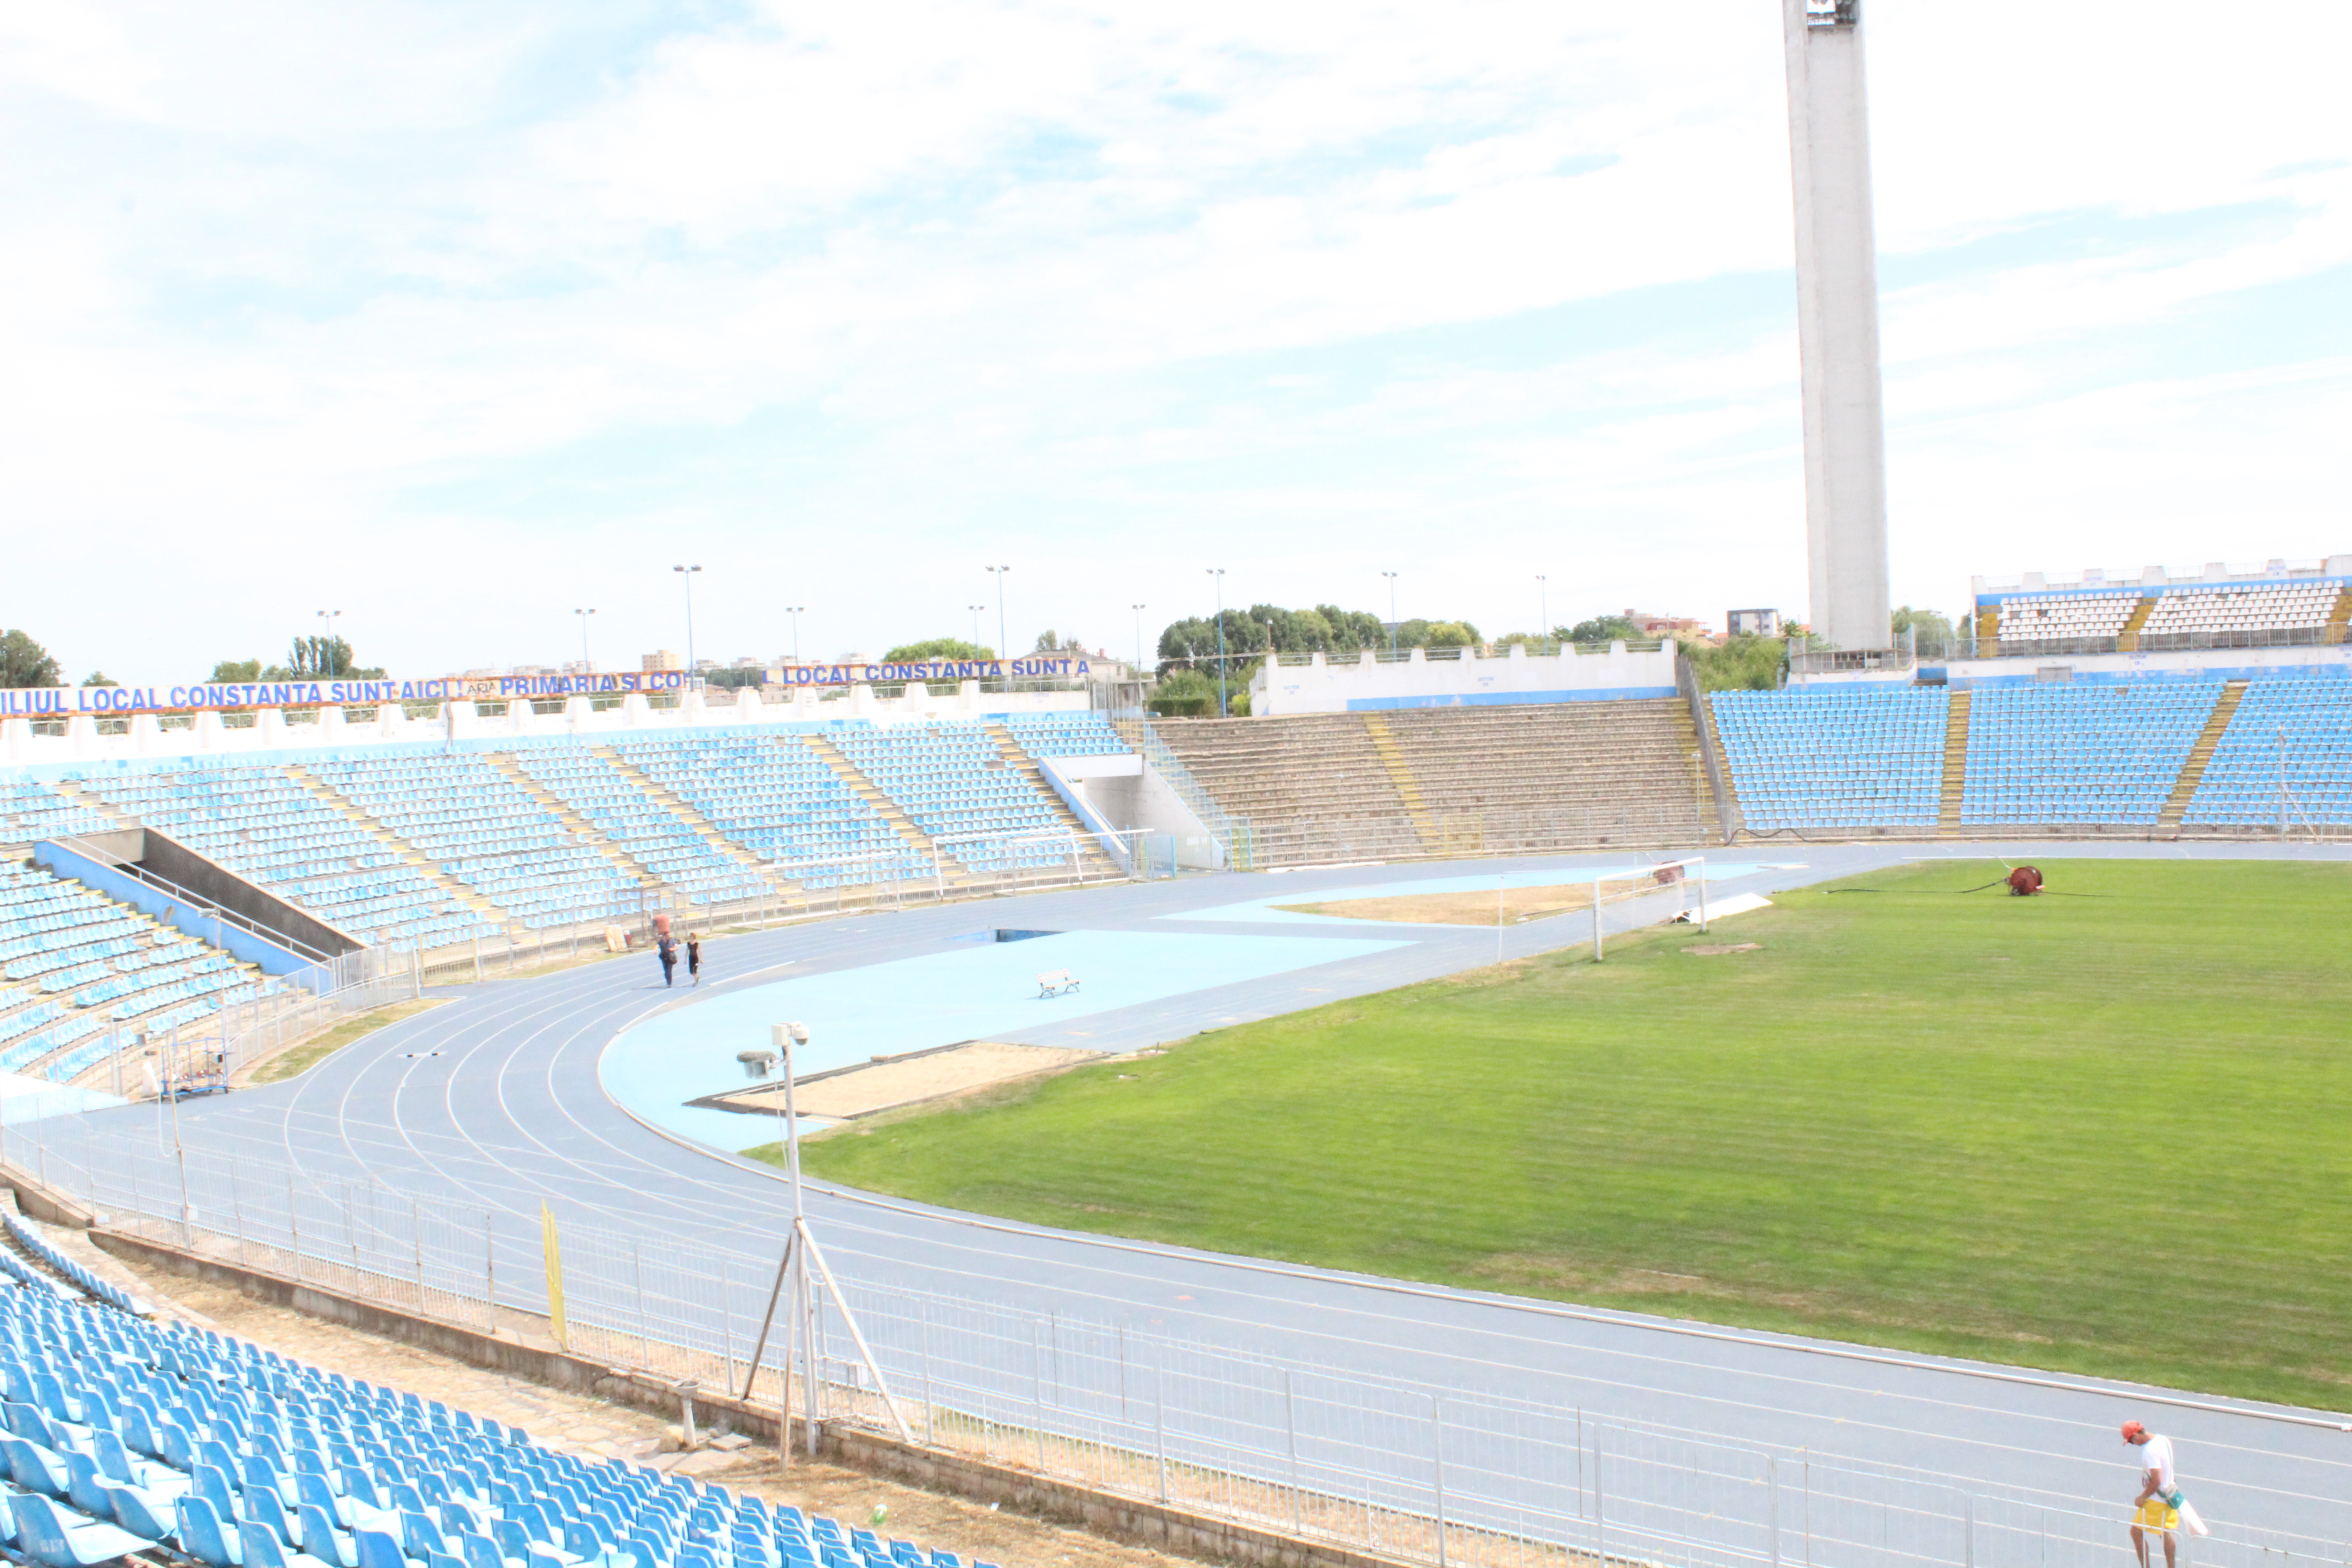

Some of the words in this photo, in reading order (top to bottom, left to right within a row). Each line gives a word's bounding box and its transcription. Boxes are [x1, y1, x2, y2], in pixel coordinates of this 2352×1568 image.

[501, 675, 614, 695] PRIMARIA
[622, 673, 641, 691] SI
[783, 666, 858, 684] LOCAL
[866, 662, 1001, 680] CONSTANTA
[1012, 659, 1072, 675] SUNT
[1077, 660, 1089, 674] A
[0, 691, 69, 715] ILIUL
[78, 688, 162, 712] LOCAL
[170, 683, 322, 708] CONSTANTA
[331, 681, 395, 702] SUNT
[398, 681, 449, 699] AICI
